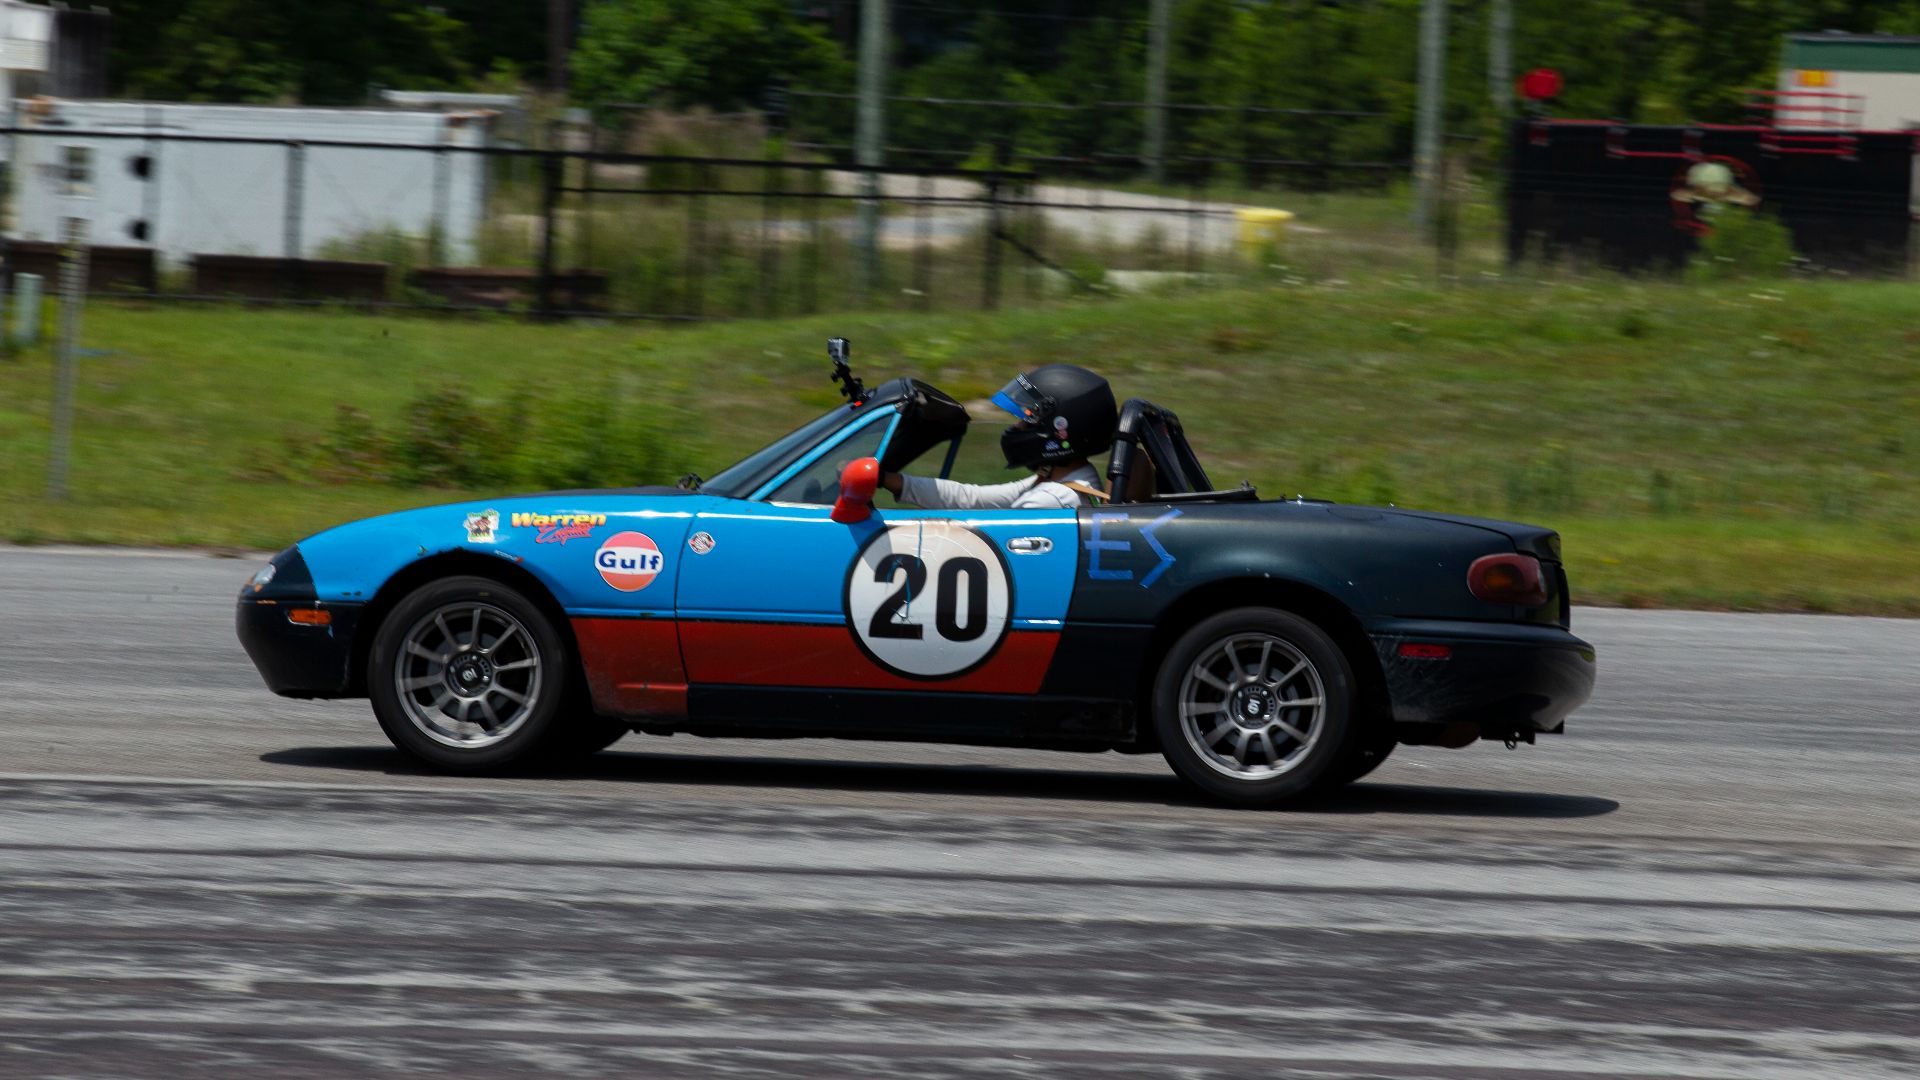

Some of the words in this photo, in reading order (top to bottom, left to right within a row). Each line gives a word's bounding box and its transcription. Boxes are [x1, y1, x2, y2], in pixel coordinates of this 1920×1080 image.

[511, 512, 607, 527] Warren
[598, 550, 660, 570] Gulf
[868, 552, 988, 642] 20
